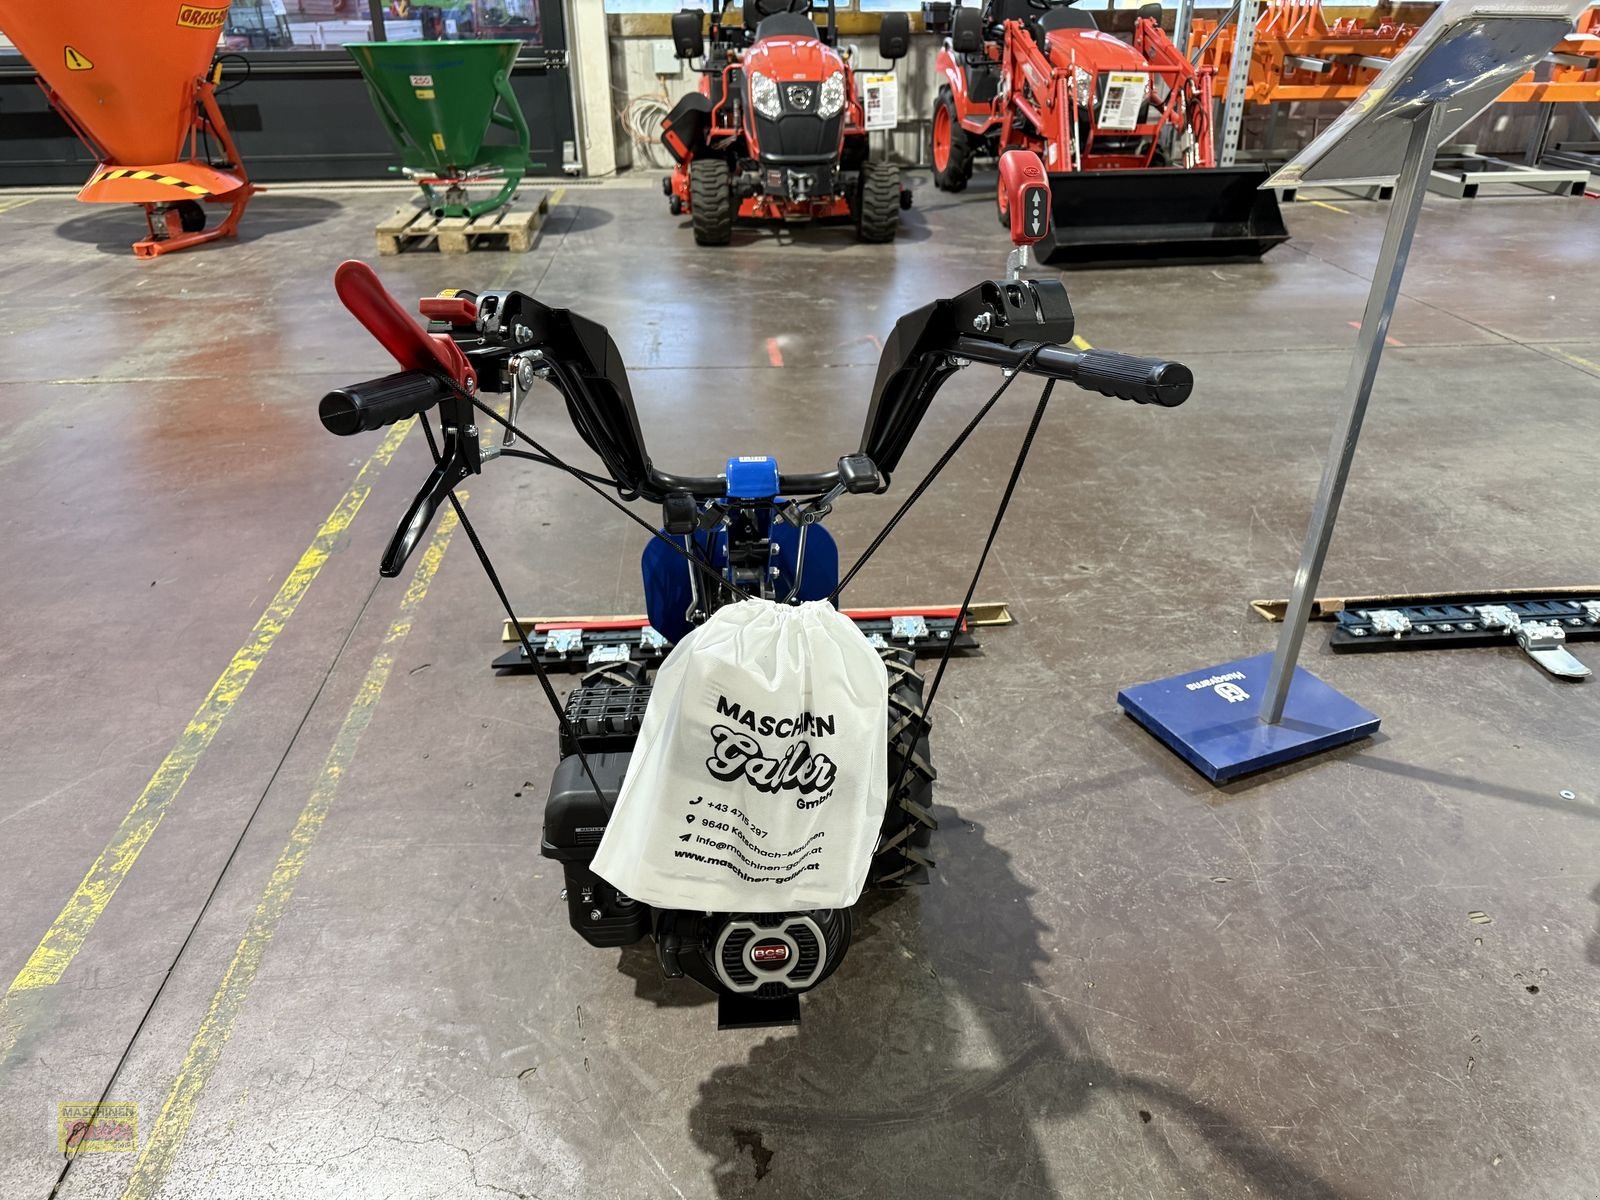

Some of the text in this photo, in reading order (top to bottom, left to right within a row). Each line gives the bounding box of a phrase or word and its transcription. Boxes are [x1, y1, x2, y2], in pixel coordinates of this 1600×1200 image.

[1185, 671, 1246, 691] Husqvarna
[796, 789, 833, 810] GmbH
[707, 801, 768, 839] +43 4715 297
[696, 834, 823, 872] info@maschinen-gaer.at
[701, 818, 825, 859] 9640 Kötschach-Mauen
[755, 948, 785, 957] BCS
